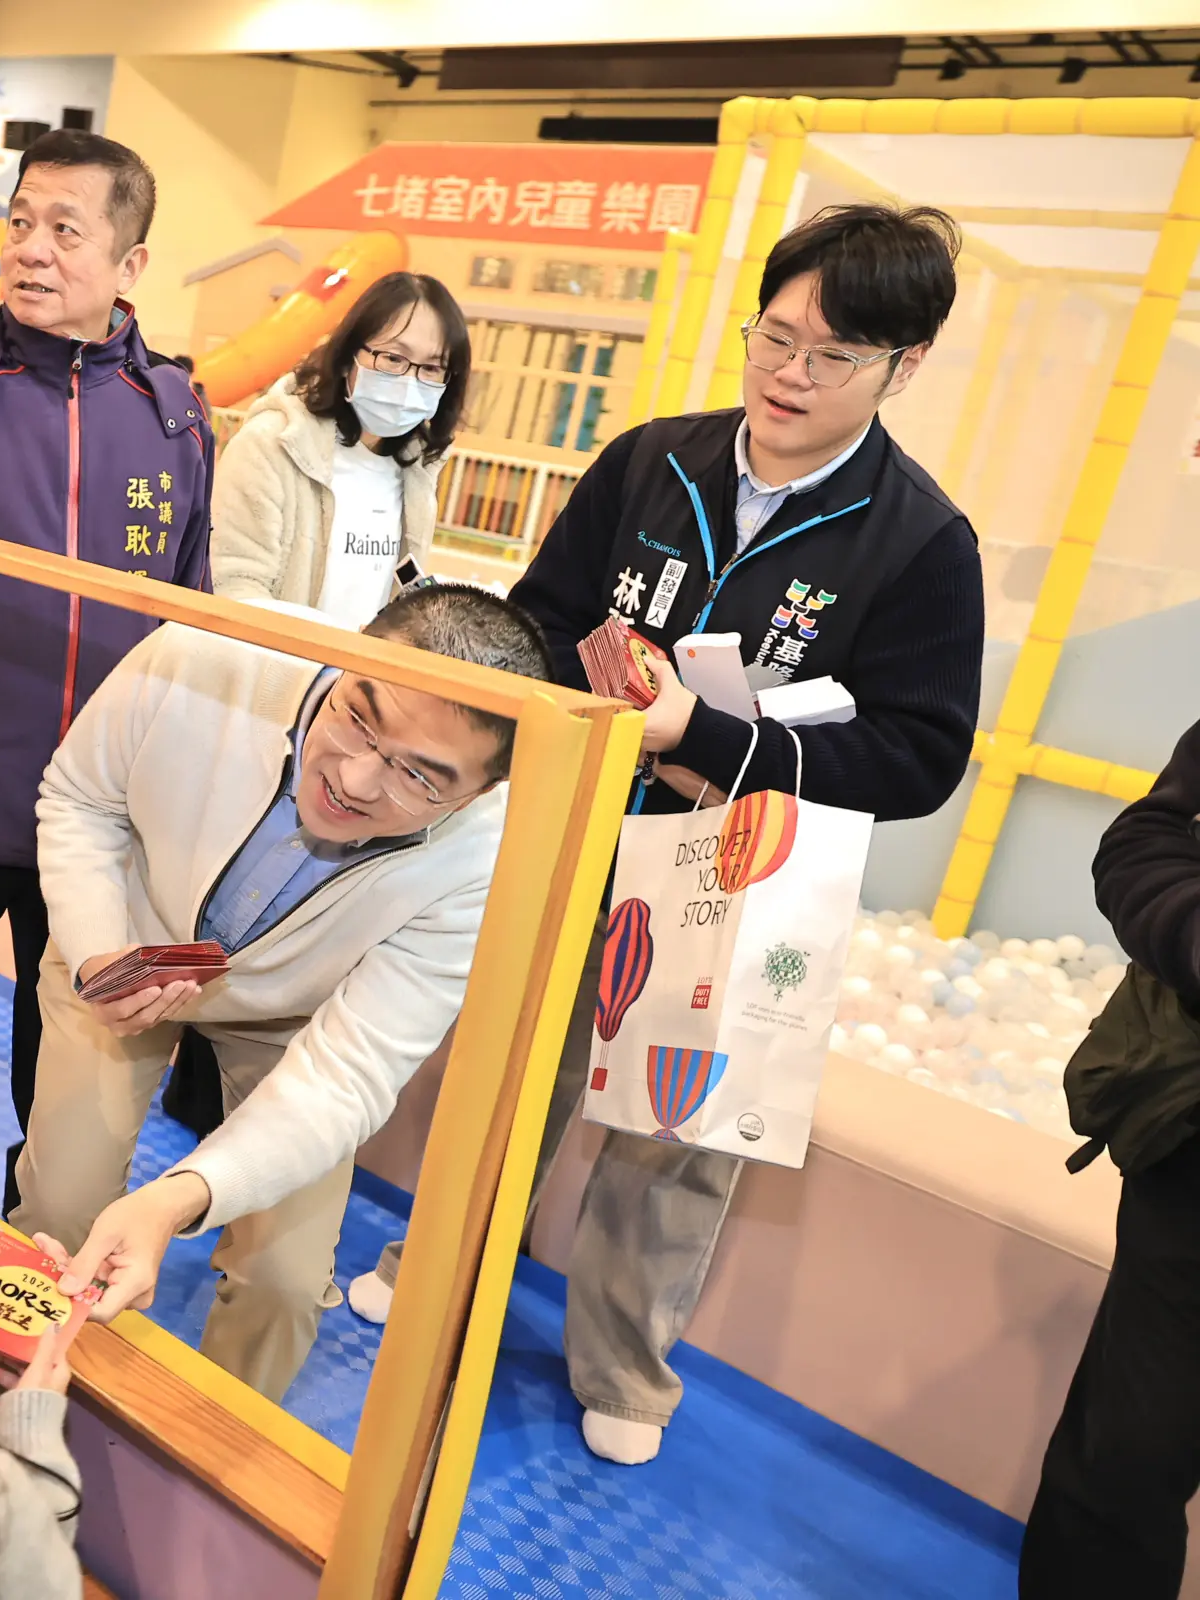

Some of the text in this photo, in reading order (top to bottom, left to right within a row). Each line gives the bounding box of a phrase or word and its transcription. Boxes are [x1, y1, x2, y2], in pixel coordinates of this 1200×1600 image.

[354, 173, 700, 234] 七堵室內兒童樂園
[125, 478, 155, 577] 張耿
[156, 471, 173, 554] 市議員
[609, 566, 647, 625] 林
[648, 561, 684, 626] 副發言人
[675, 830, 751, 867] DISCOVER
[697, 863, 741, 893] YOUR
[680, 898, 732, 928] STORY
[693, 997, 708, 1005] FREE
[695, 988, 710, 996] DUTY
[22, 1274, 51, 1292] 2026
